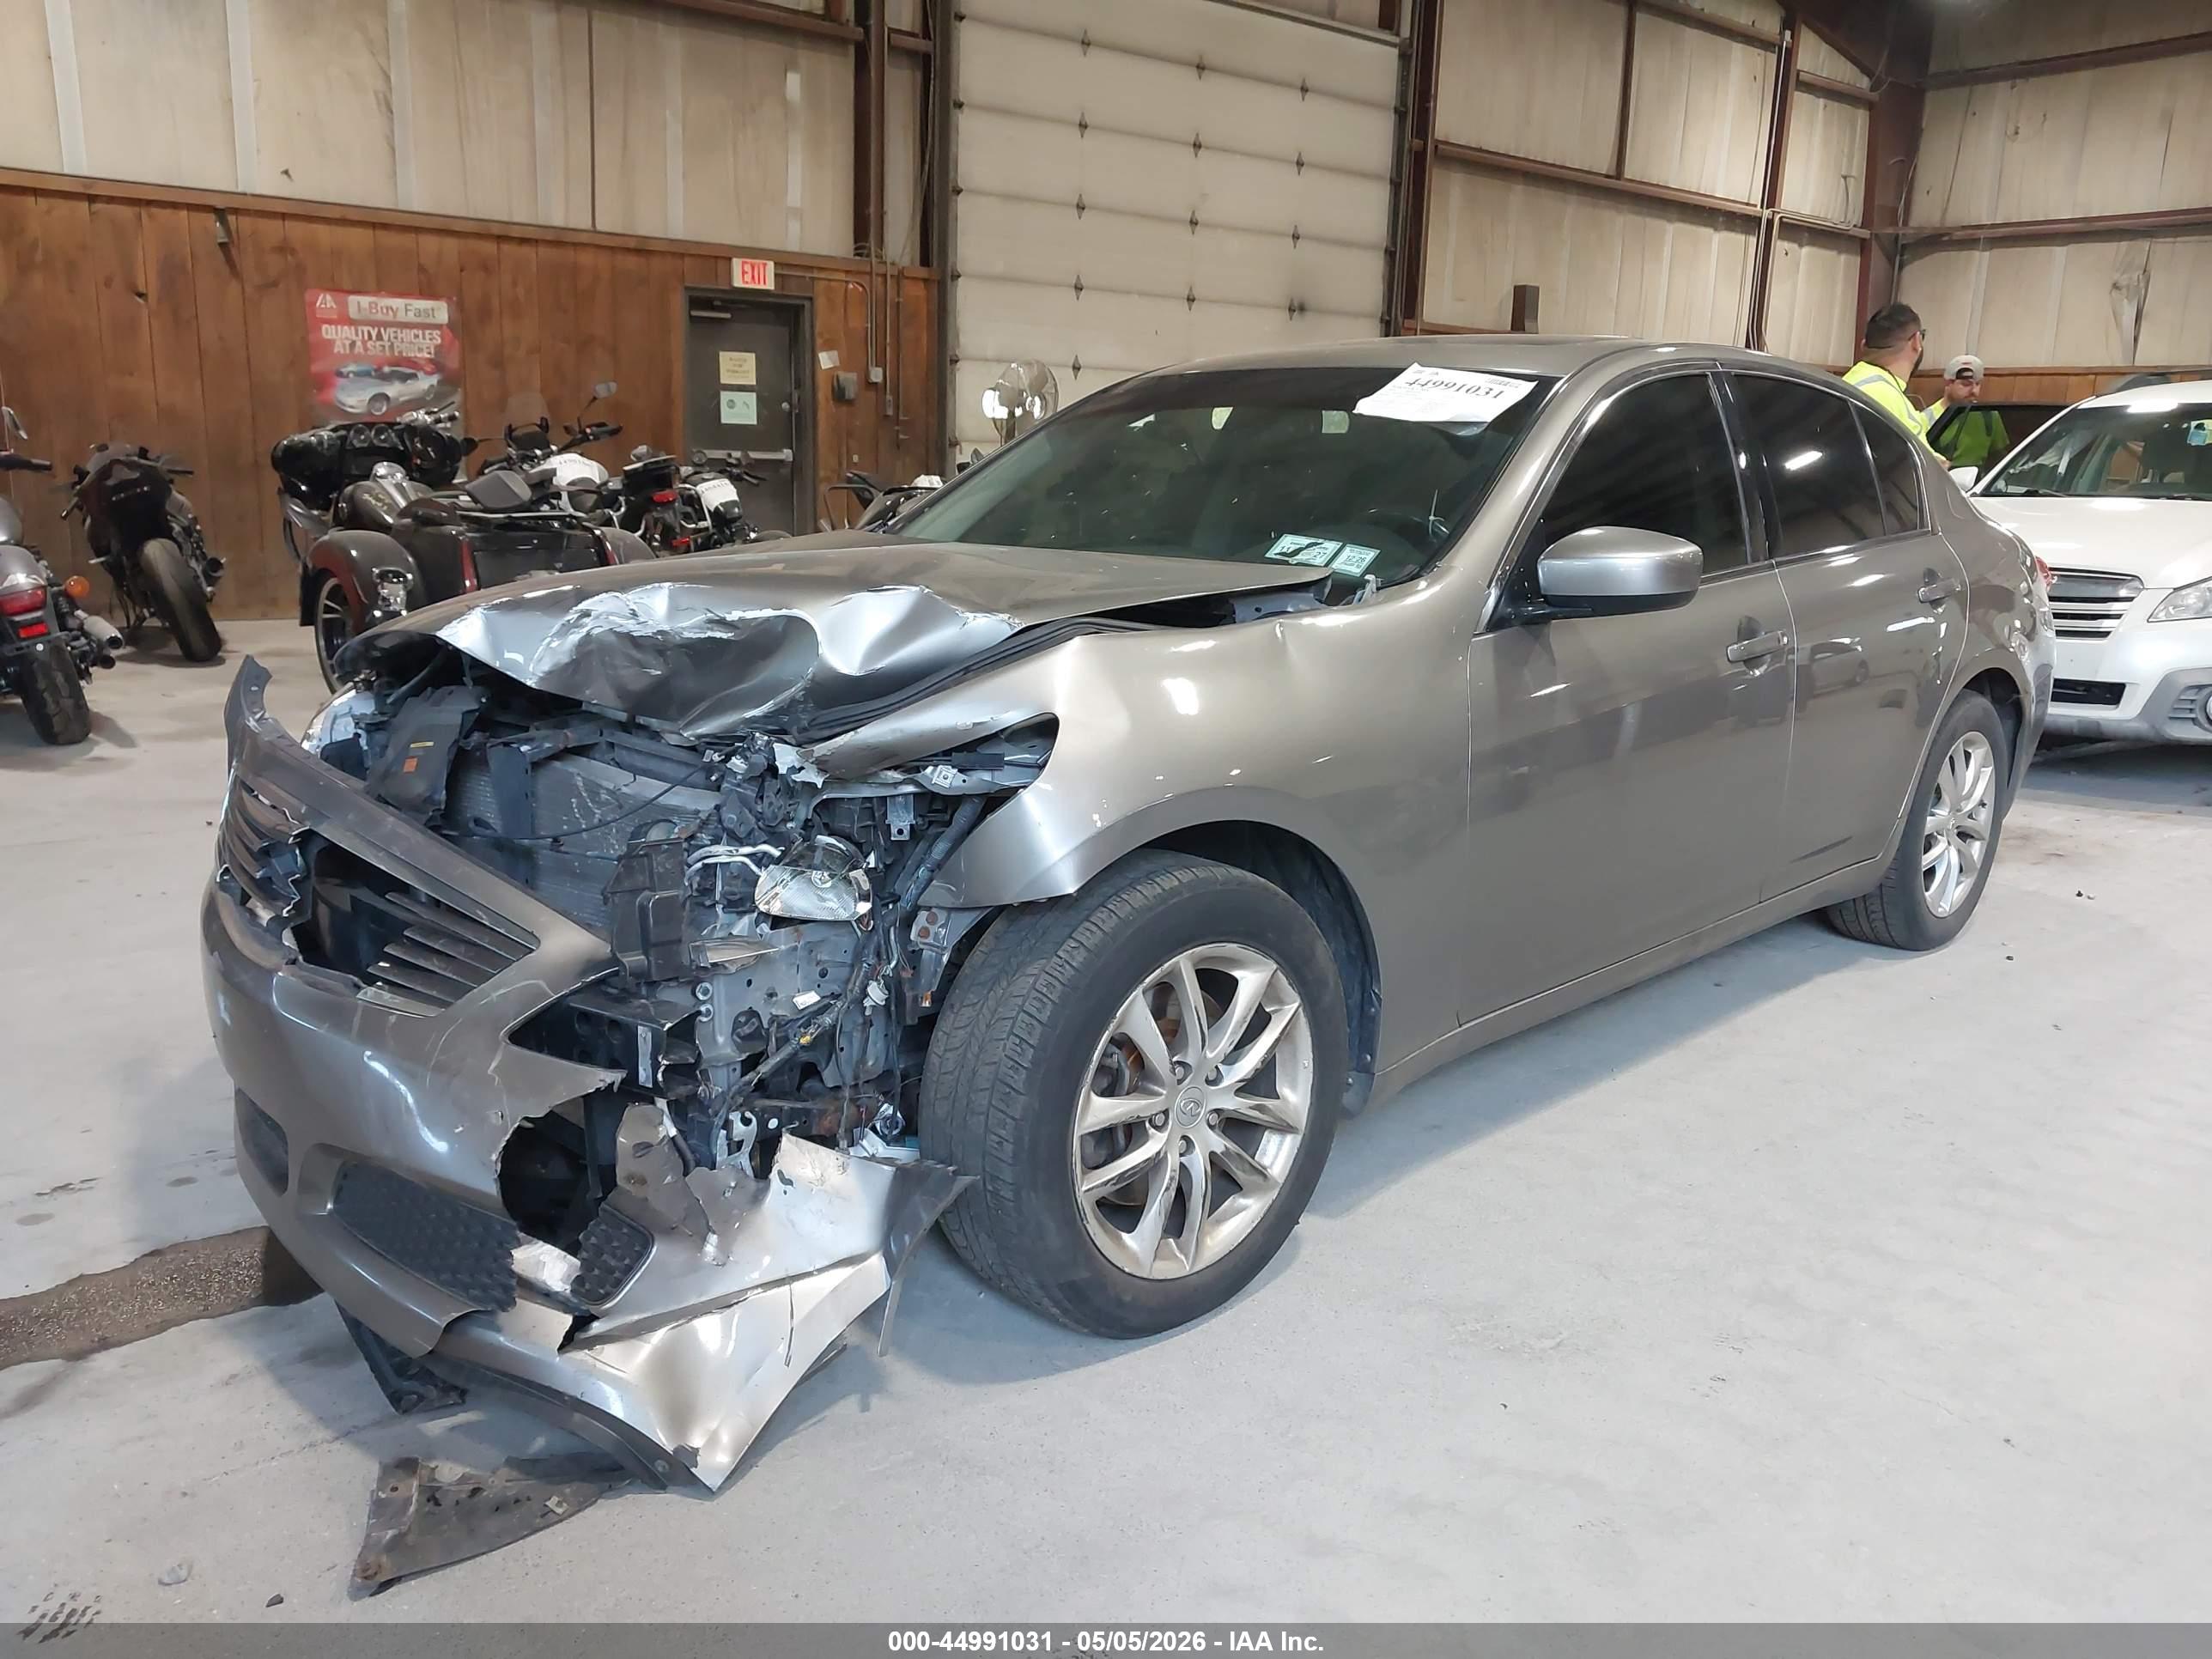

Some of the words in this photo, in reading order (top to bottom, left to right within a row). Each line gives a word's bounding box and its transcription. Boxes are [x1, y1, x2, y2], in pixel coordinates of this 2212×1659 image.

[741, 261, 768, 285] EXIT
[404, 303, 436, 319] Fast
[322, 324, 378, 341] QUALITY
[381, 327, 441, 343] VEHICLES
[333, 341, 353, 354] AT
[355, 341, 364, 355] A
[368, 342, 391, 356] SET
[394, 343, 435, 358] PRICE!
[1406, 378, 1504, 398] 44991031
